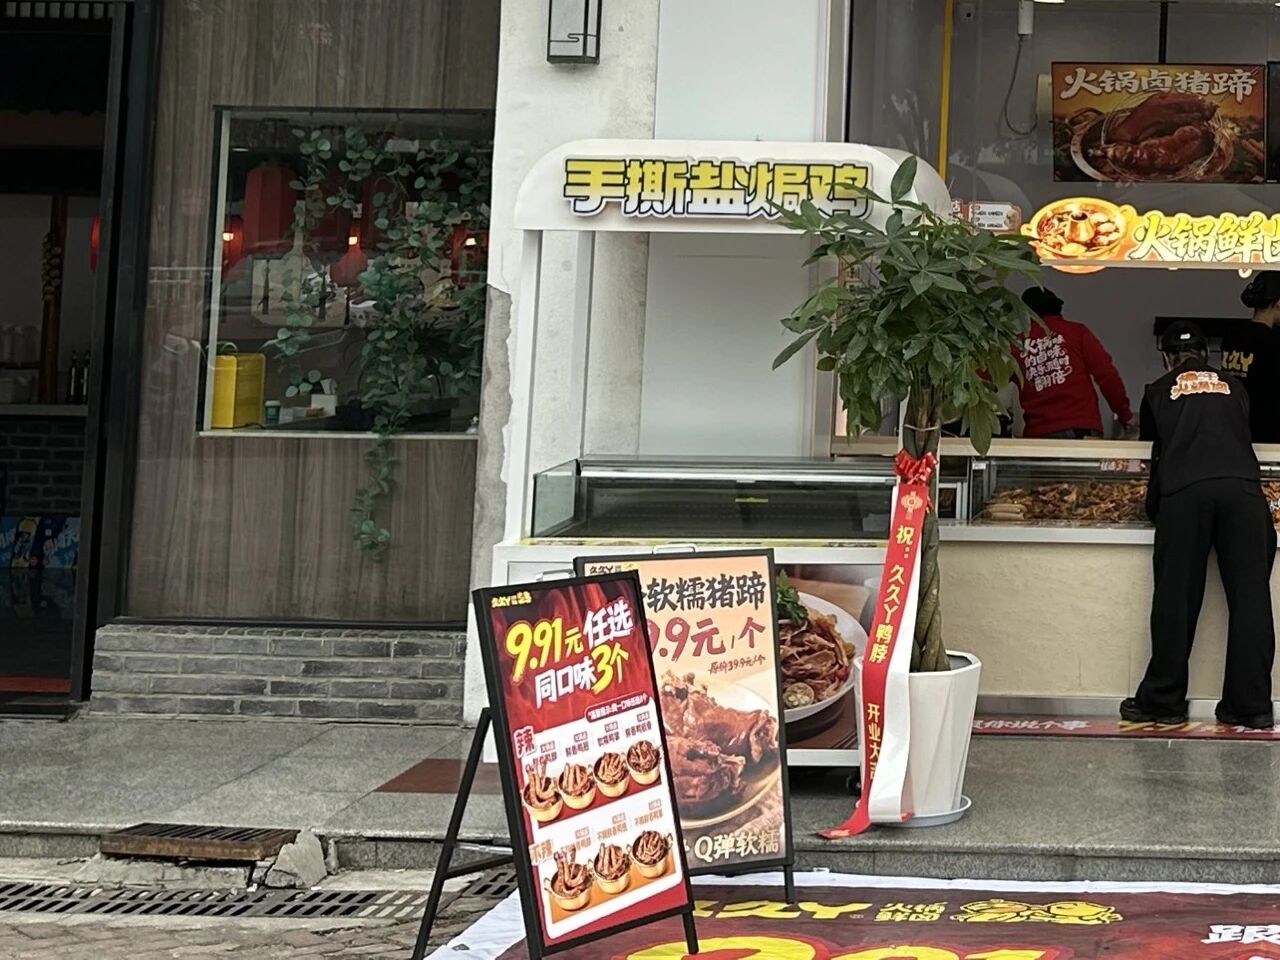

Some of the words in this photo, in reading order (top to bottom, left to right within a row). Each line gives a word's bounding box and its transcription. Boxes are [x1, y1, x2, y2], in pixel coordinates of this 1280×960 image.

[1060, 67, 1257, 103] 火锅卤猪蹄
[564, 158, 871, 217] 手撕盐焗鸡
[641, 570, 767, 613] 软糯猪蹄
[535, 642, 630, 709] 同口味3个
